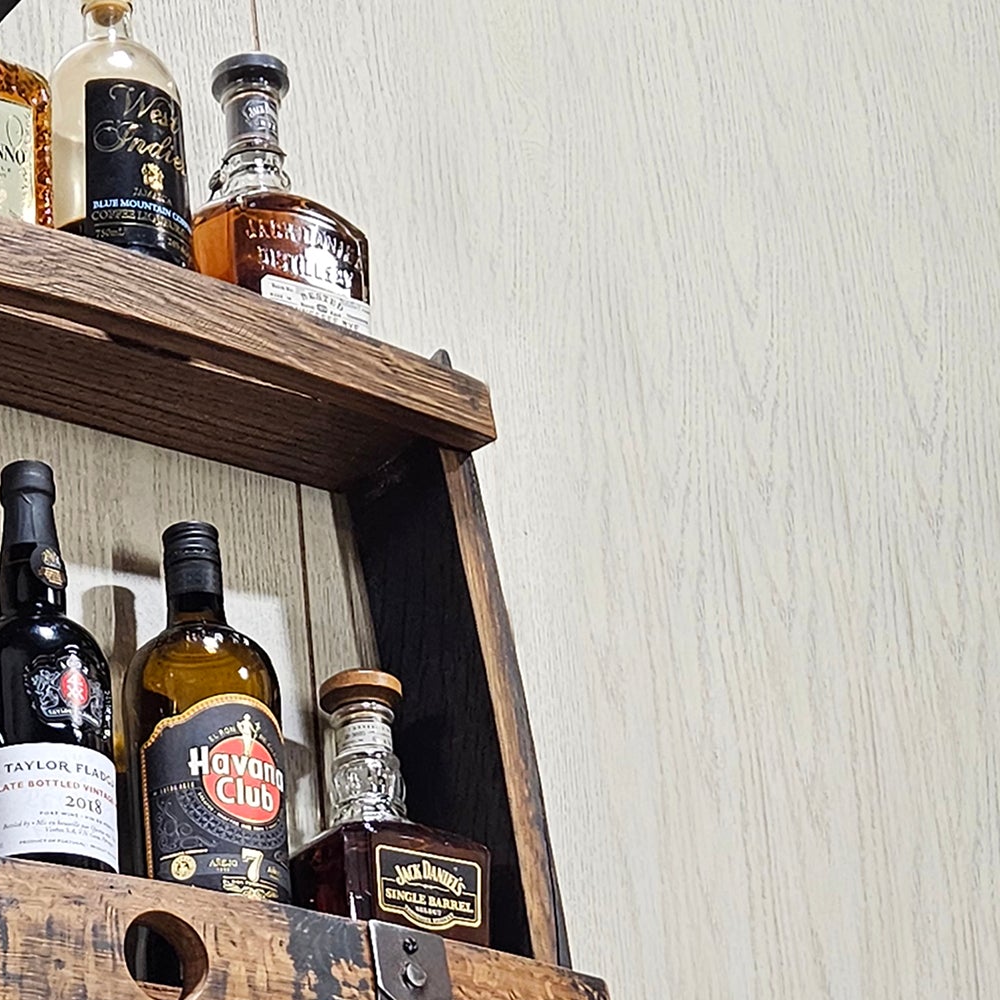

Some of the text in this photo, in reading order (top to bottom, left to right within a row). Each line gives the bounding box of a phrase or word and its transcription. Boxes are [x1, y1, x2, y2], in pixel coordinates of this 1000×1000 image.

[109, 84, 180, 135] West
[93, 199, 119, 209] BLUE
[120, 199, 172, 217] MOUNTAIN
[4, 760, 71, 774] TAYLOR
[188, 745, 284, 793] Havana
[28, 779, 80, 789] BOTTLED
[216, 776, 274, 812] Club
[65, 796, 102, 815] 2018
[241, 847, 264, 883] 7
[395, 859, 467, 897] JACK DANIEL'S
[385, 887, 474, 913] SINGLE BARREL
